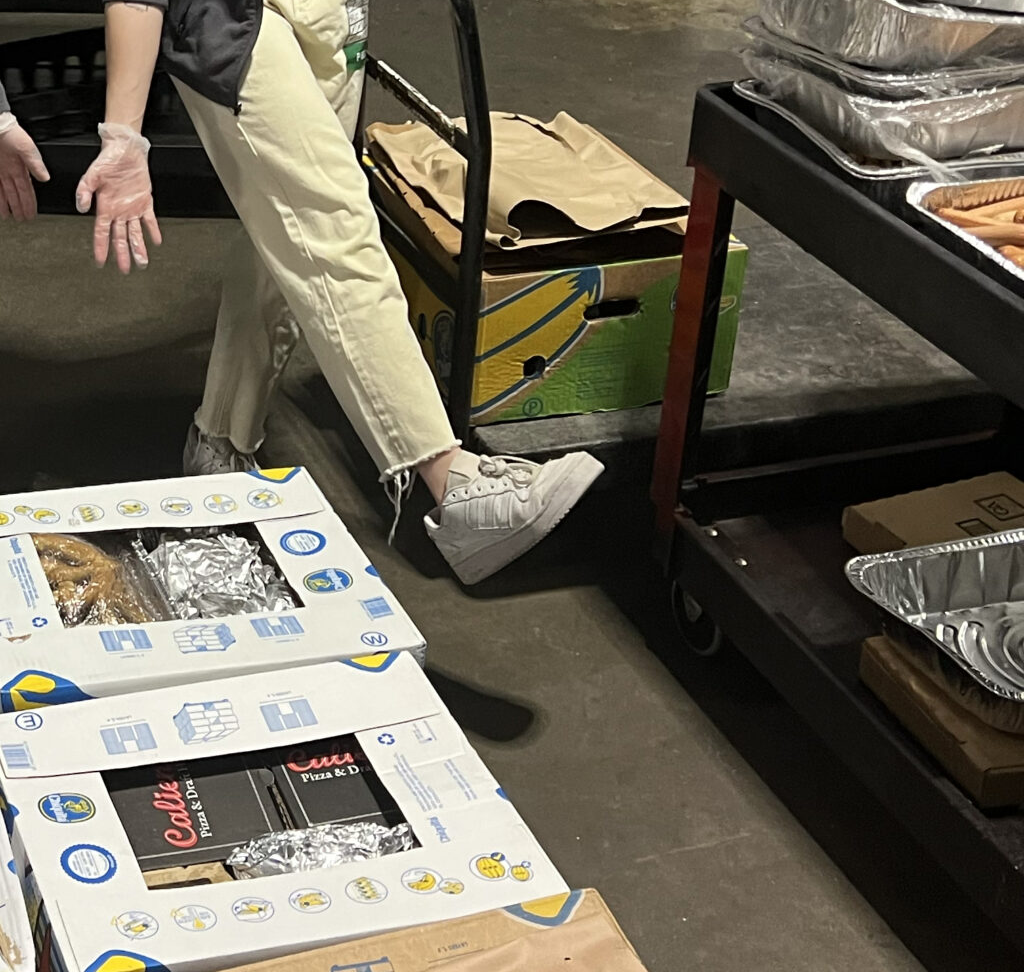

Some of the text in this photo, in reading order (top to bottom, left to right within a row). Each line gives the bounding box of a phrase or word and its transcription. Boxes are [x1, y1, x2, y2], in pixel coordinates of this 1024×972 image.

[300, 771, 333, 783] Pizza
[334, 768, 346, 777] &
[191, 800, 203, 811] &
[197, 811, 213, 838] Pizza
